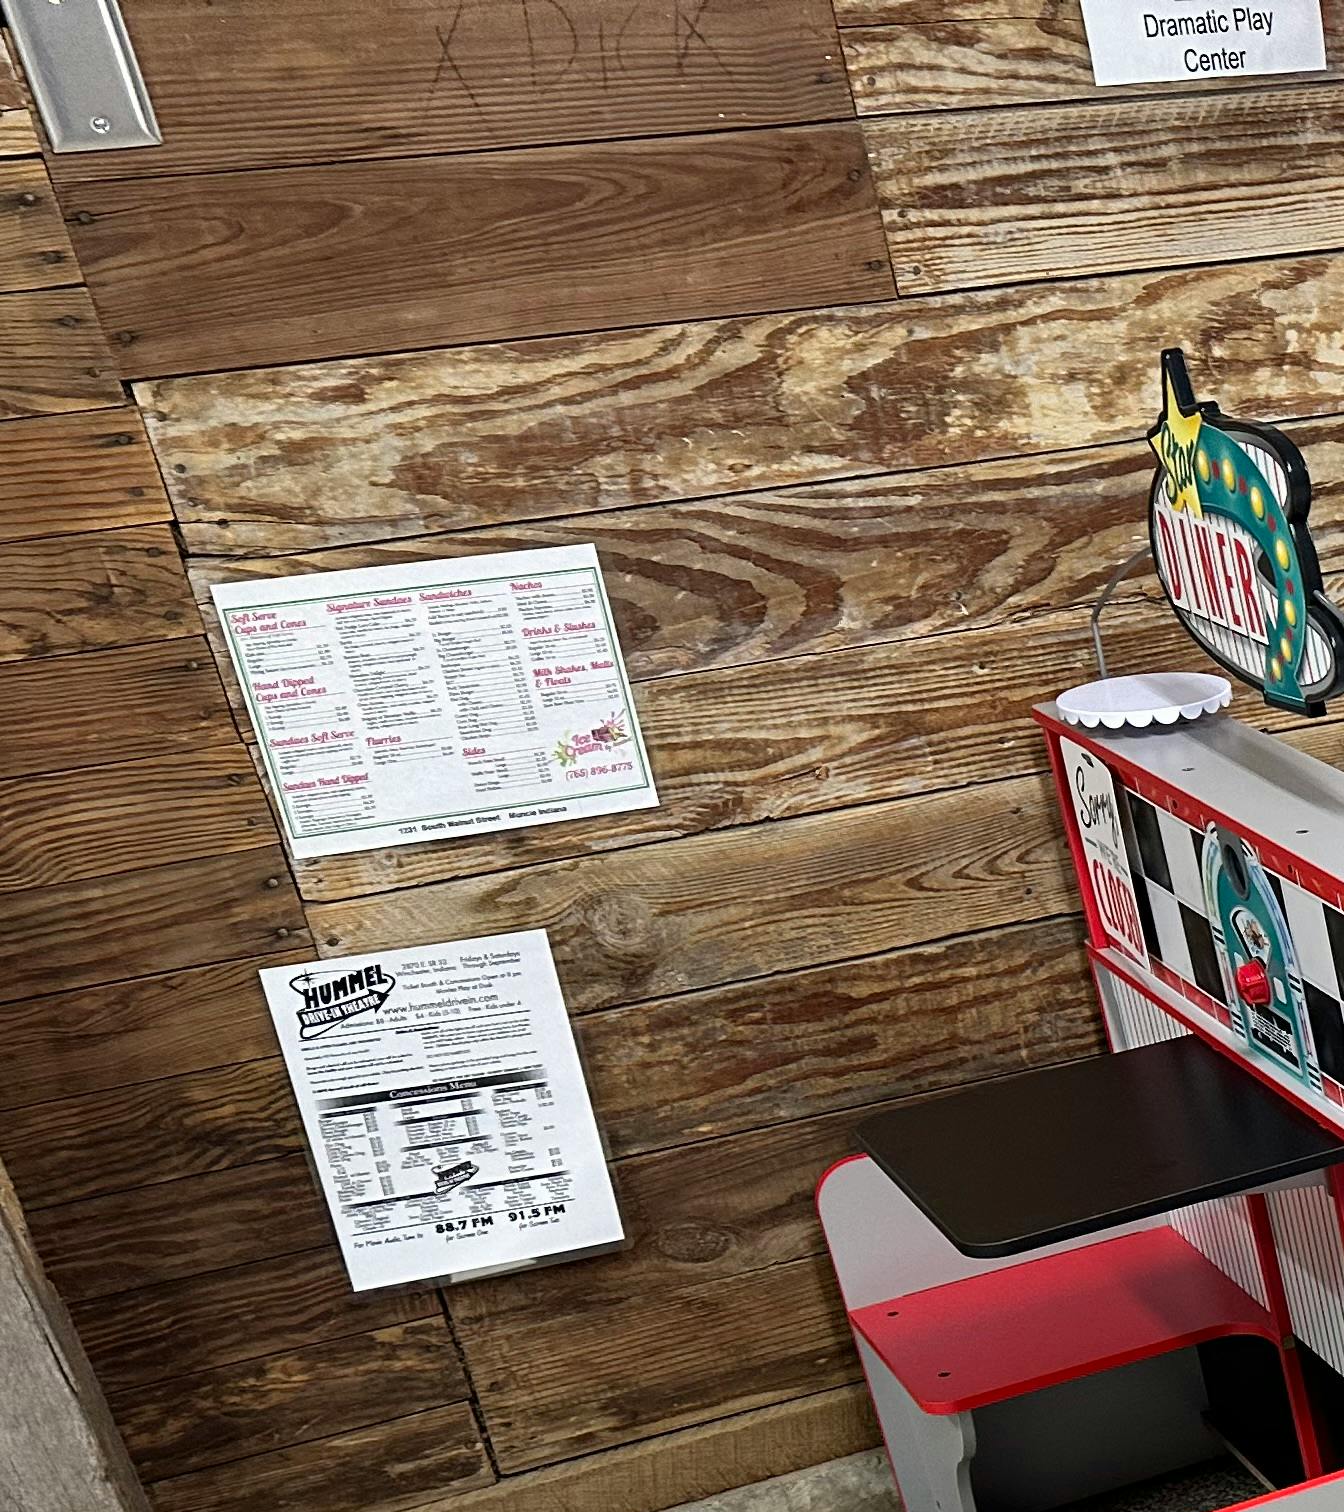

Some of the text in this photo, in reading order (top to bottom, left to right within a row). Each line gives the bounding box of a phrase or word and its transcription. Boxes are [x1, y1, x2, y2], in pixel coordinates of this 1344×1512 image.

[1144, 7, 1274, 38] Dramatic Play
[1183, 48, 1247, 73] Center
[1160, 421, 1194, 504] Star
[1157, 512, 1267, 639] DINER
[418, 587, 472, 601] Sandwiches
[509, 579, 542, 591] Nachos
[250, 610, 277, 621] Serve
[324, 599, 371, 614] Signature
[258, 621, 278, 631] and
[278, 689, 298, 698] and
[309, 731, 330, 744] Soft
[570, 732, 592, 746] Ice
[461, 745, 486, 756] Sides
[563, 741, 603, 758] Cream
[420, 821, 446, 831] South
[475, 813, 501, 823] Street
[302, 963, 389, 1010] HUMMEL
[300, 994, 382, 1027] DRIVE-IN THEATRE
[381, 989, 499, 1017] www.hummeldrivein.com
[388, 1078, 478, 1100] Concessions Menu
[508, 1203, 566, 1222] 91.5 FM
[434, 1214, 494, 1234] 88.7 FM
